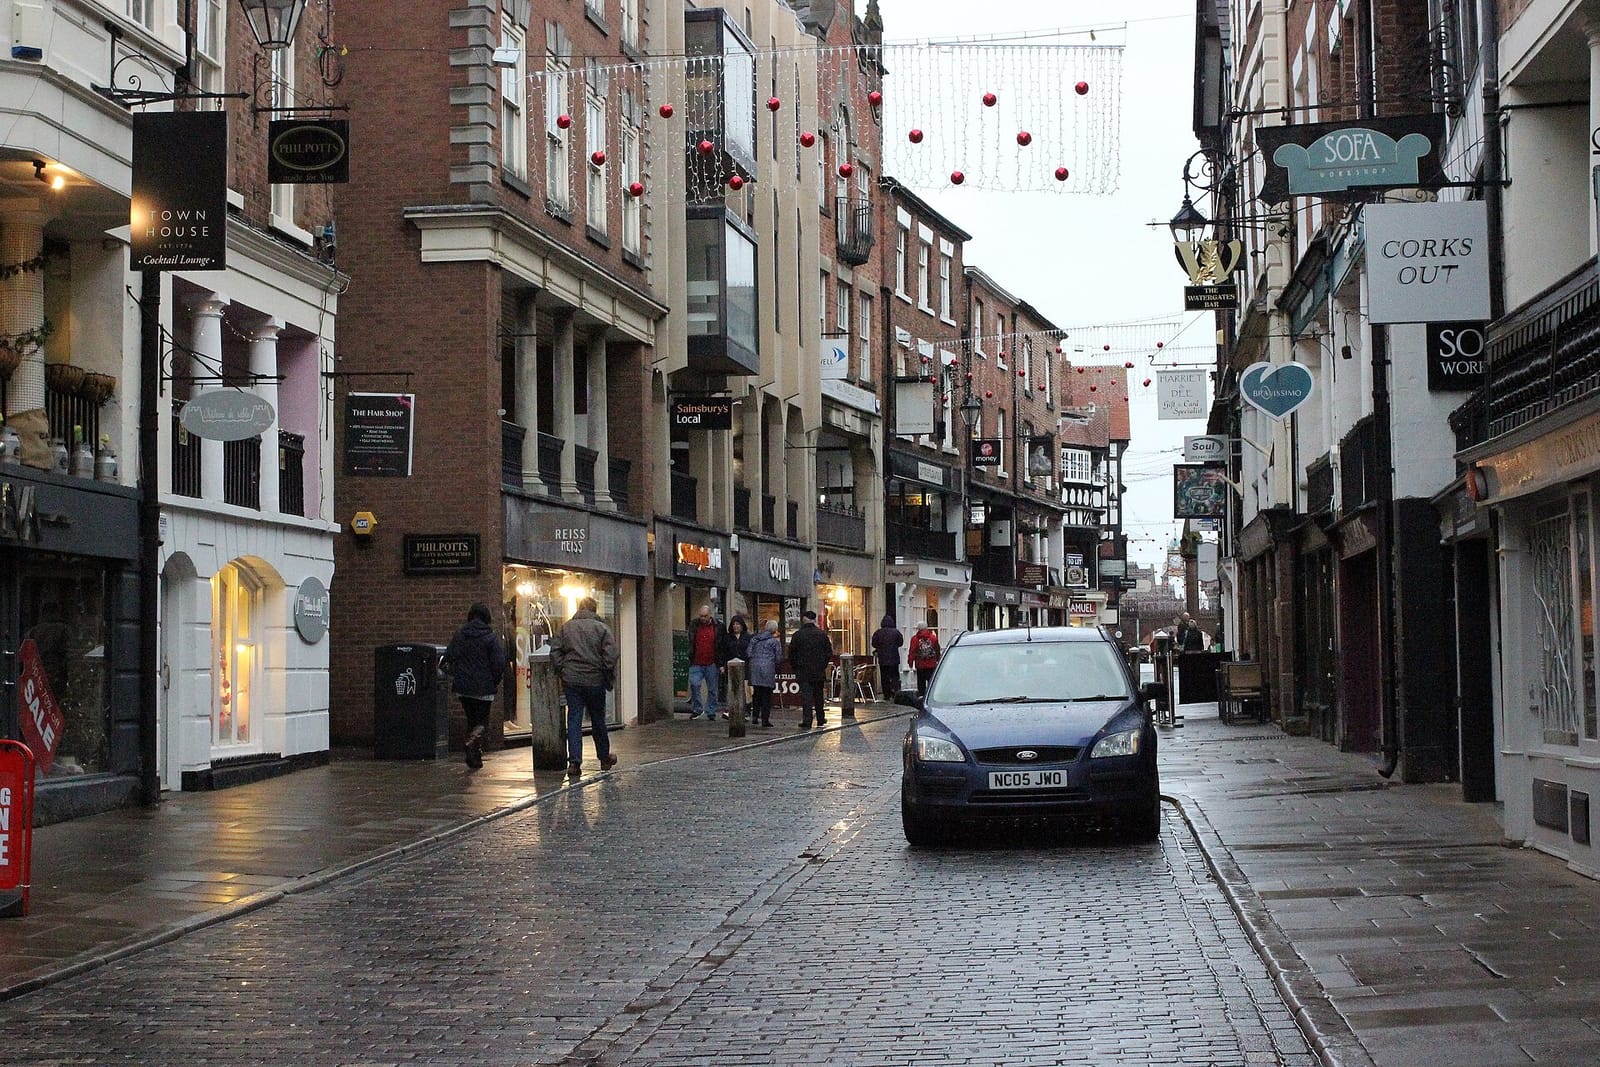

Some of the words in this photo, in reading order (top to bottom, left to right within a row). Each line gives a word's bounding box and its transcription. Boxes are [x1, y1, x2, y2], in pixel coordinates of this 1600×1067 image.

[279, 143, 339, 153] PHILPOTTS
[1324, 133, 1381, 163] SOFA
[147, 209, 206, 221] TOWN
[145, 226, 209, 237] HOUSE
[1381, 237, 1473, 259] CORKS
[143, 254, 179, 265] Cocktail
[179, 254, 211, 267] Lounge
[1397, 264, 1459, 285] OUT
[1187, 294, 1236, 302] WATERGATES
[1439, 328, 1484, 357] SO
[1159, 374, 1203, 383] HARRIET
[1170, 389, 1193, 398] DEE
[1252, 385, 1302, 400] BRAVISSIMO
[352, 408, 366, 417] THE
[367, 409, 384, 417] HAIR
[385, 409, 404, 417] SHOP
[676, 403, 729, 415] Sainsbury's
[676, 413, 701, 424] Local
[1191, 442, 1215, 451] Soul
[356, 519, 369, 528] ADT
[555, 528, 586, 540] REISS
[415, 542, 470, 552] PHILPOTTS
[561, 540, 584, 553] REISS
[1074, 558, 1082, 566] LET
[769, 556, 790, 581] COSTA
[1070, 603, 1094, 613] AMUEL
[24, 678, 55, 752] SALE
[1035, 771, 1062, 786] JWO
